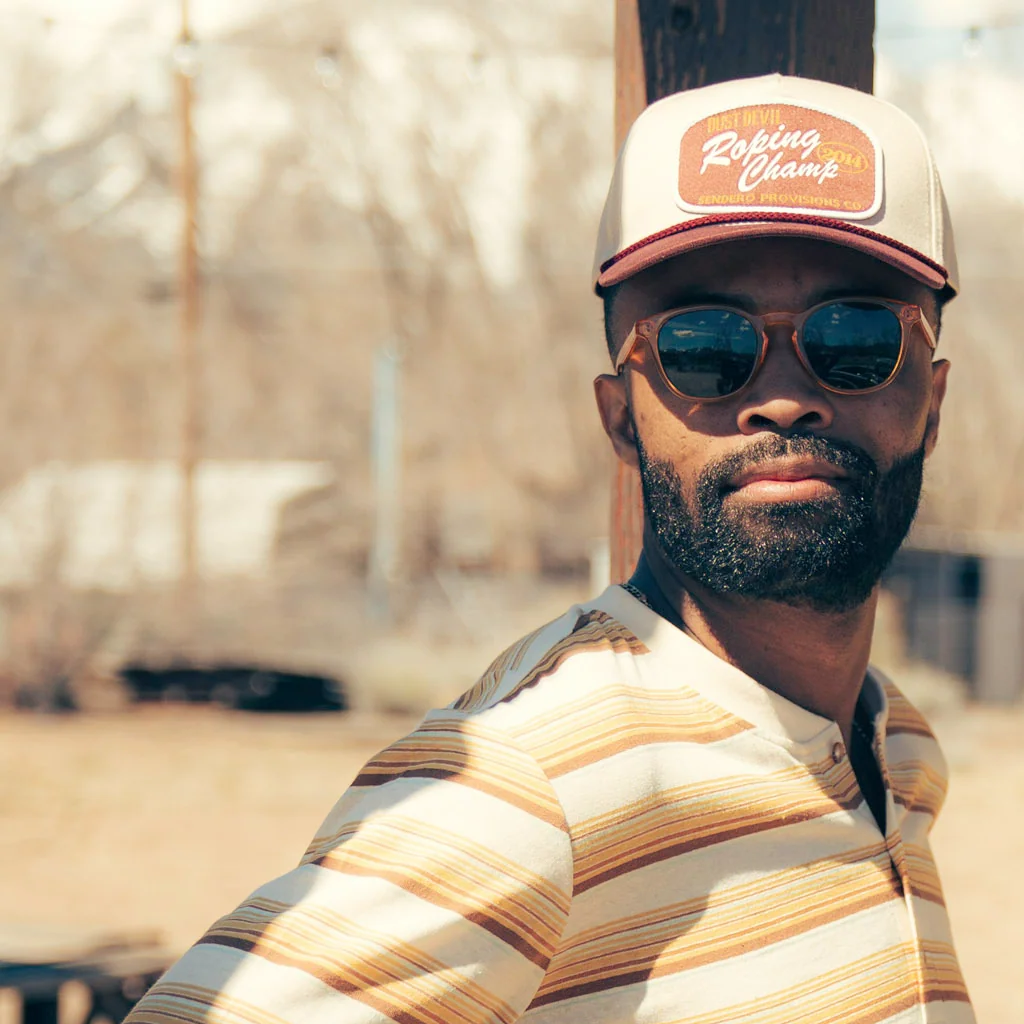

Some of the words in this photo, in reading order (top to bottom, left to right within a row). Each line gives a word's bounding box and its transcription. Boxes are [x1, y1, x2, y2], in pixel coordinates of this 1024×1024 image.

[707, 113, 741, 133] DUST
[743, 109, 781, 127] DEVIL
[700, 124, 821, 174] Roping
[820, 147, 863, 169] 2014
[738, 152, 838, 192] Champ
[698, 194, 755, 205] SENDERO
[760, 193, 840, 208] PROVISIONS
